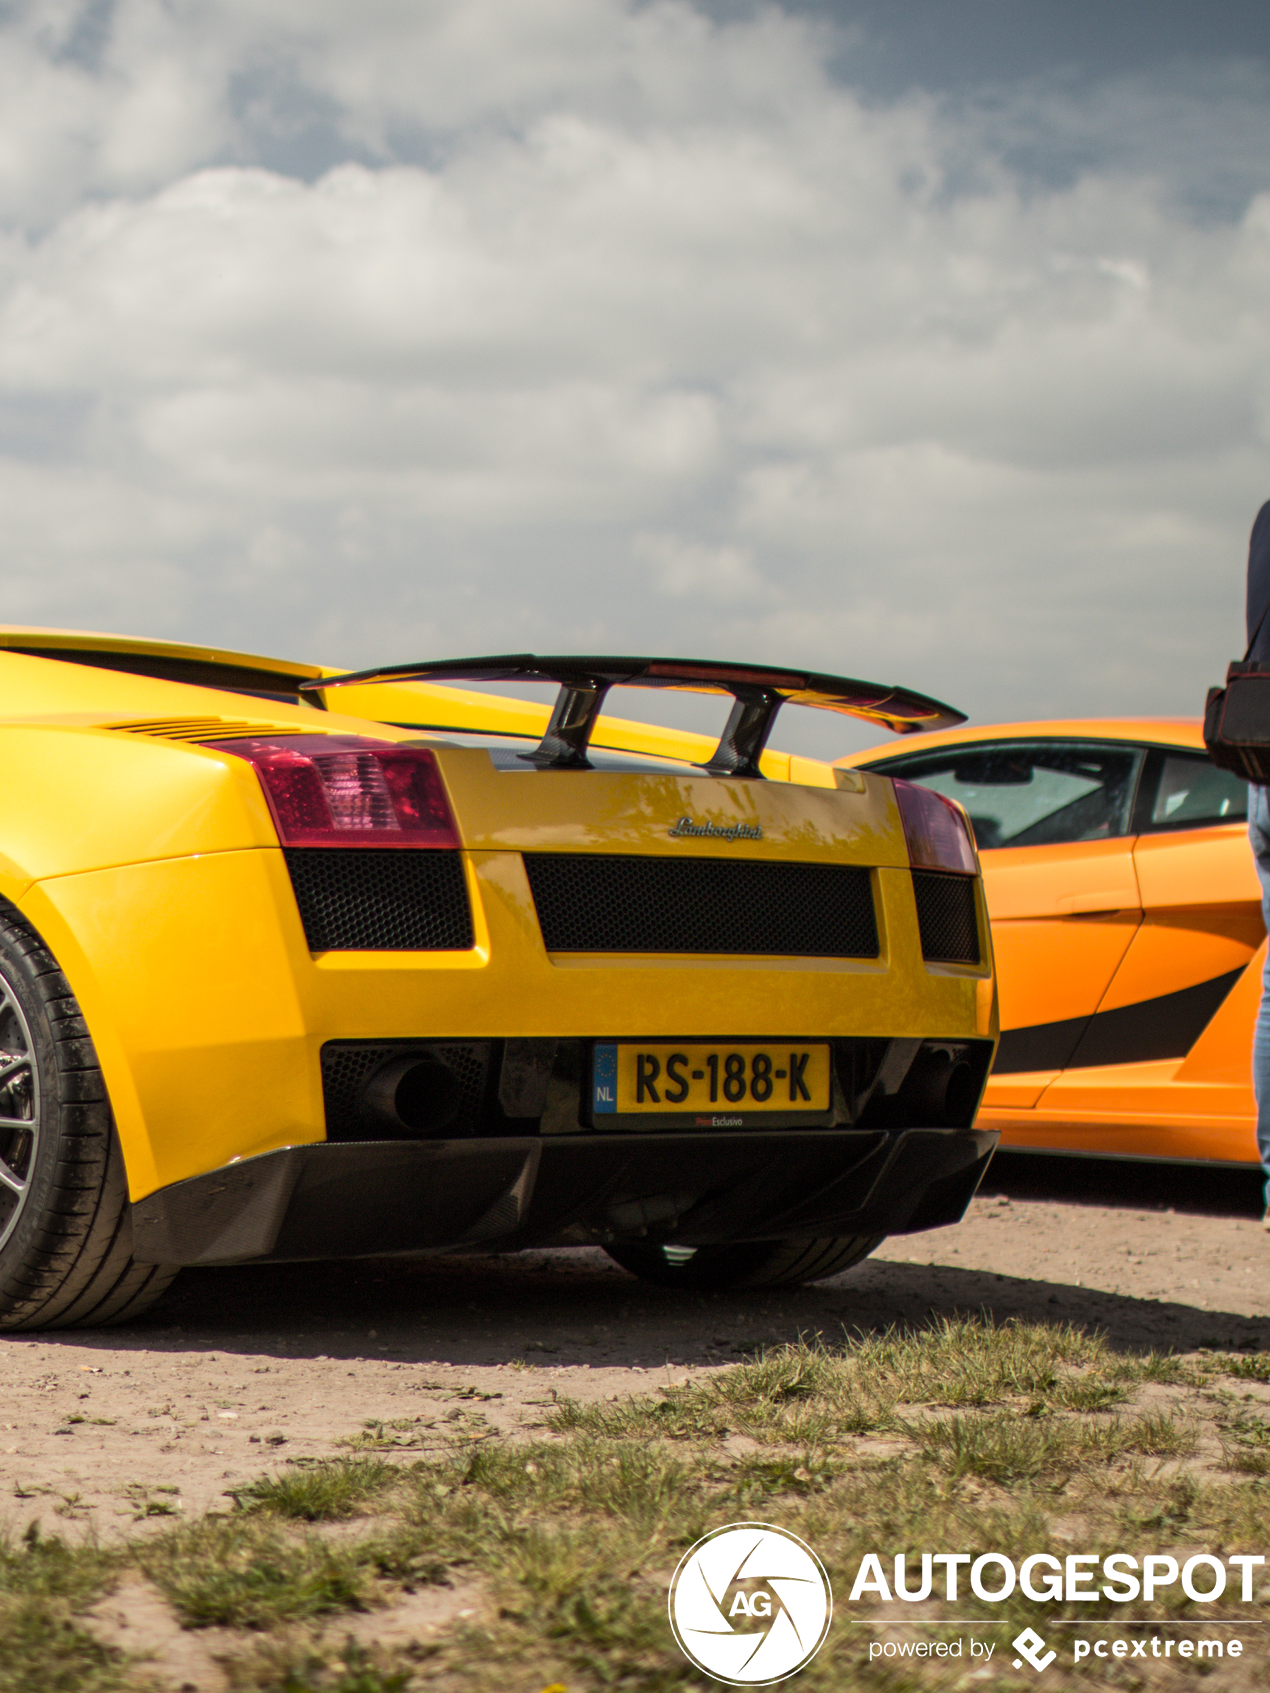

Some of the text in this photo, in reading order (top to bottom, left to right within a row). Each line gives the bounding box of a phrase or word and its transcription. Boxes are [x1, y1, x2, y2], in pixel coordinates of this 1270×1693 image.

[669, 817, 763, 842] Lamborghini
[636, 1053, 812, 1104] RS-188-K
[596, 1087, 614, 1102] NL
